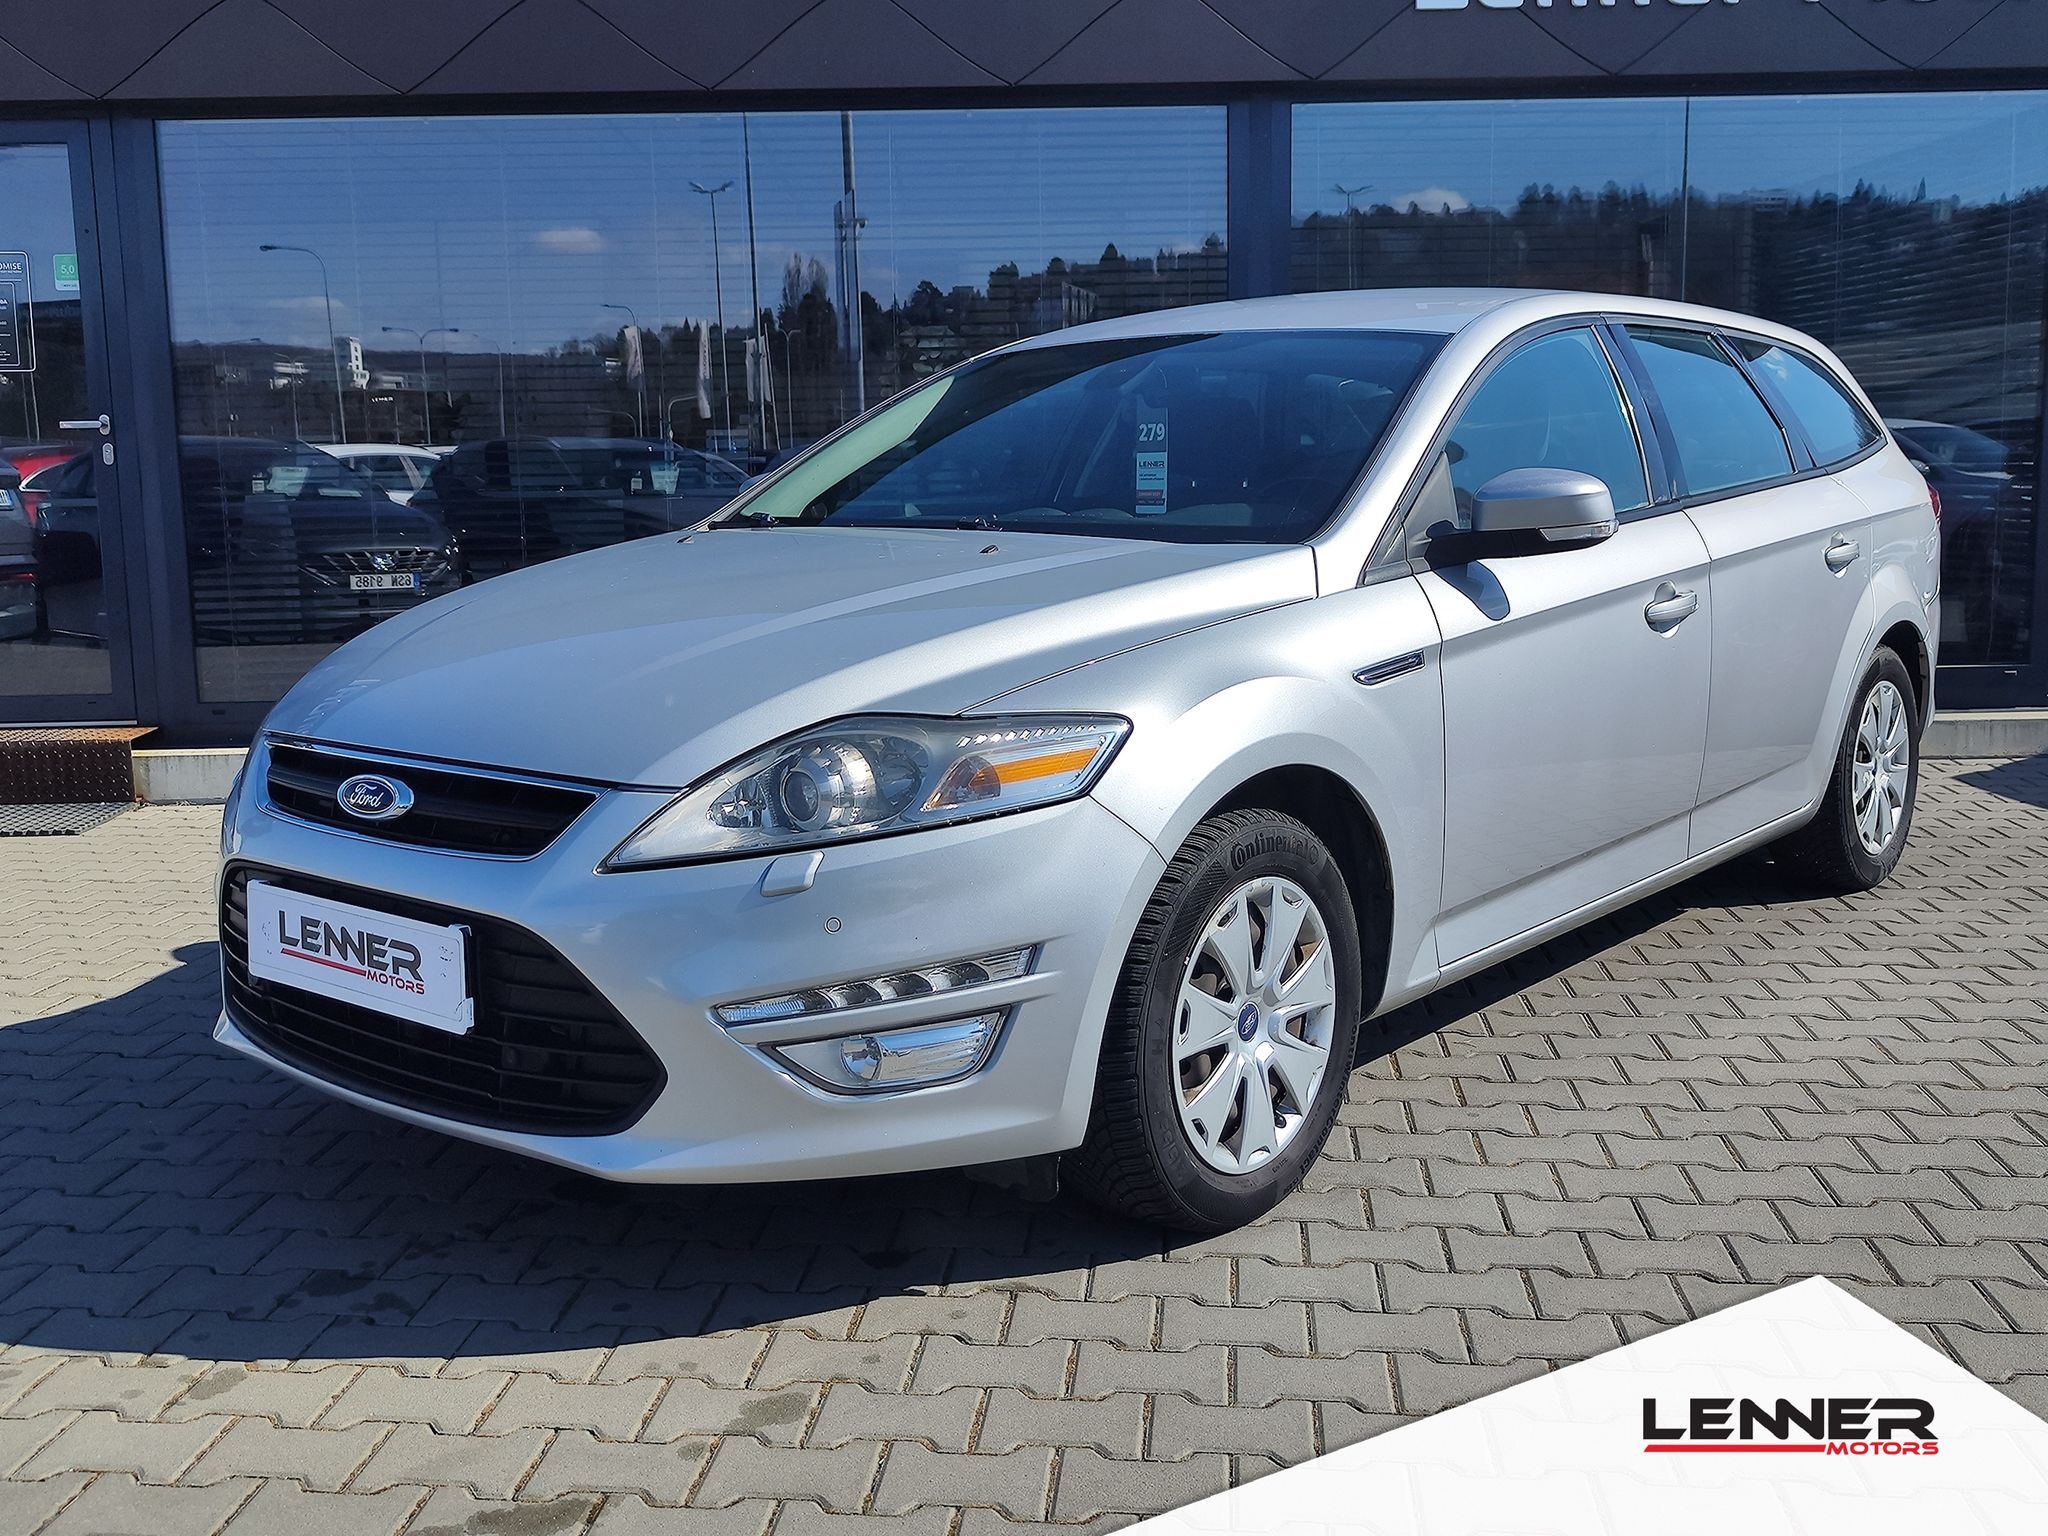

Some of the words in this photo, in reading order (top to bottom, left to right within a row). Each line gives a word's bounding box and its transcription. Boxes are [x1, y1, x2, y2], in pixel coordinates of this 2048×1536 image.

[1138, 423, 1166, 442] 279
[350, 782, 384, 808] Ford
[1230, 832, 1309, 871] Continental
[278, 910, 425, 983] LENNER
[366, 968, 425, 995] MOTORS
